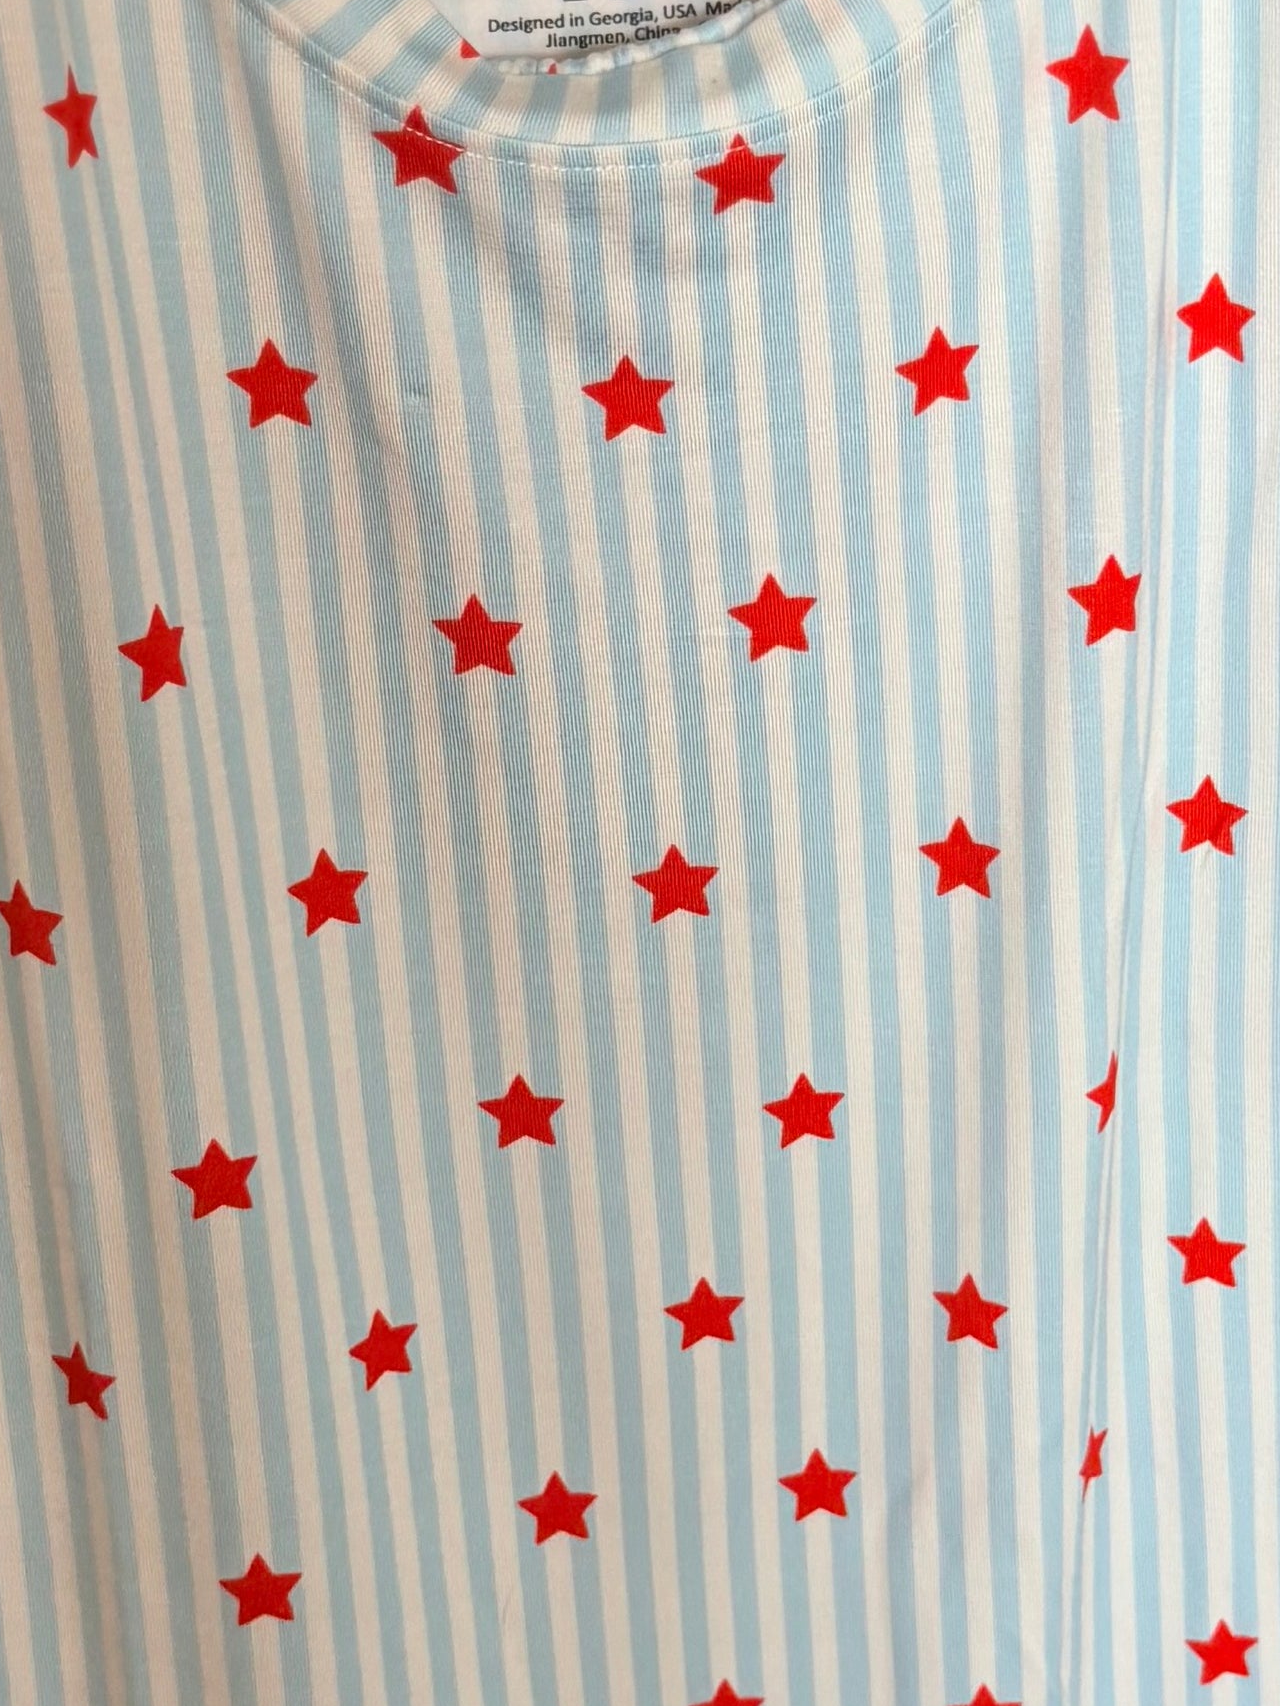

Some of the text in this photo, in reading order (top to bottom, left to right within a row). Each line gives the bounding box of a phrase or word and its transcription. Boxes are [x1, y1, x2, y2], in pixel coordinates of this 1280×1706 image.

[488, 14, 565, 33] Designed
[569, 13, 584, 27] in
[588, 7, 658, 26] Georgia,
[663, 3, 697, 19] USA
[546, 31, 630, 49] Jiangmen,
